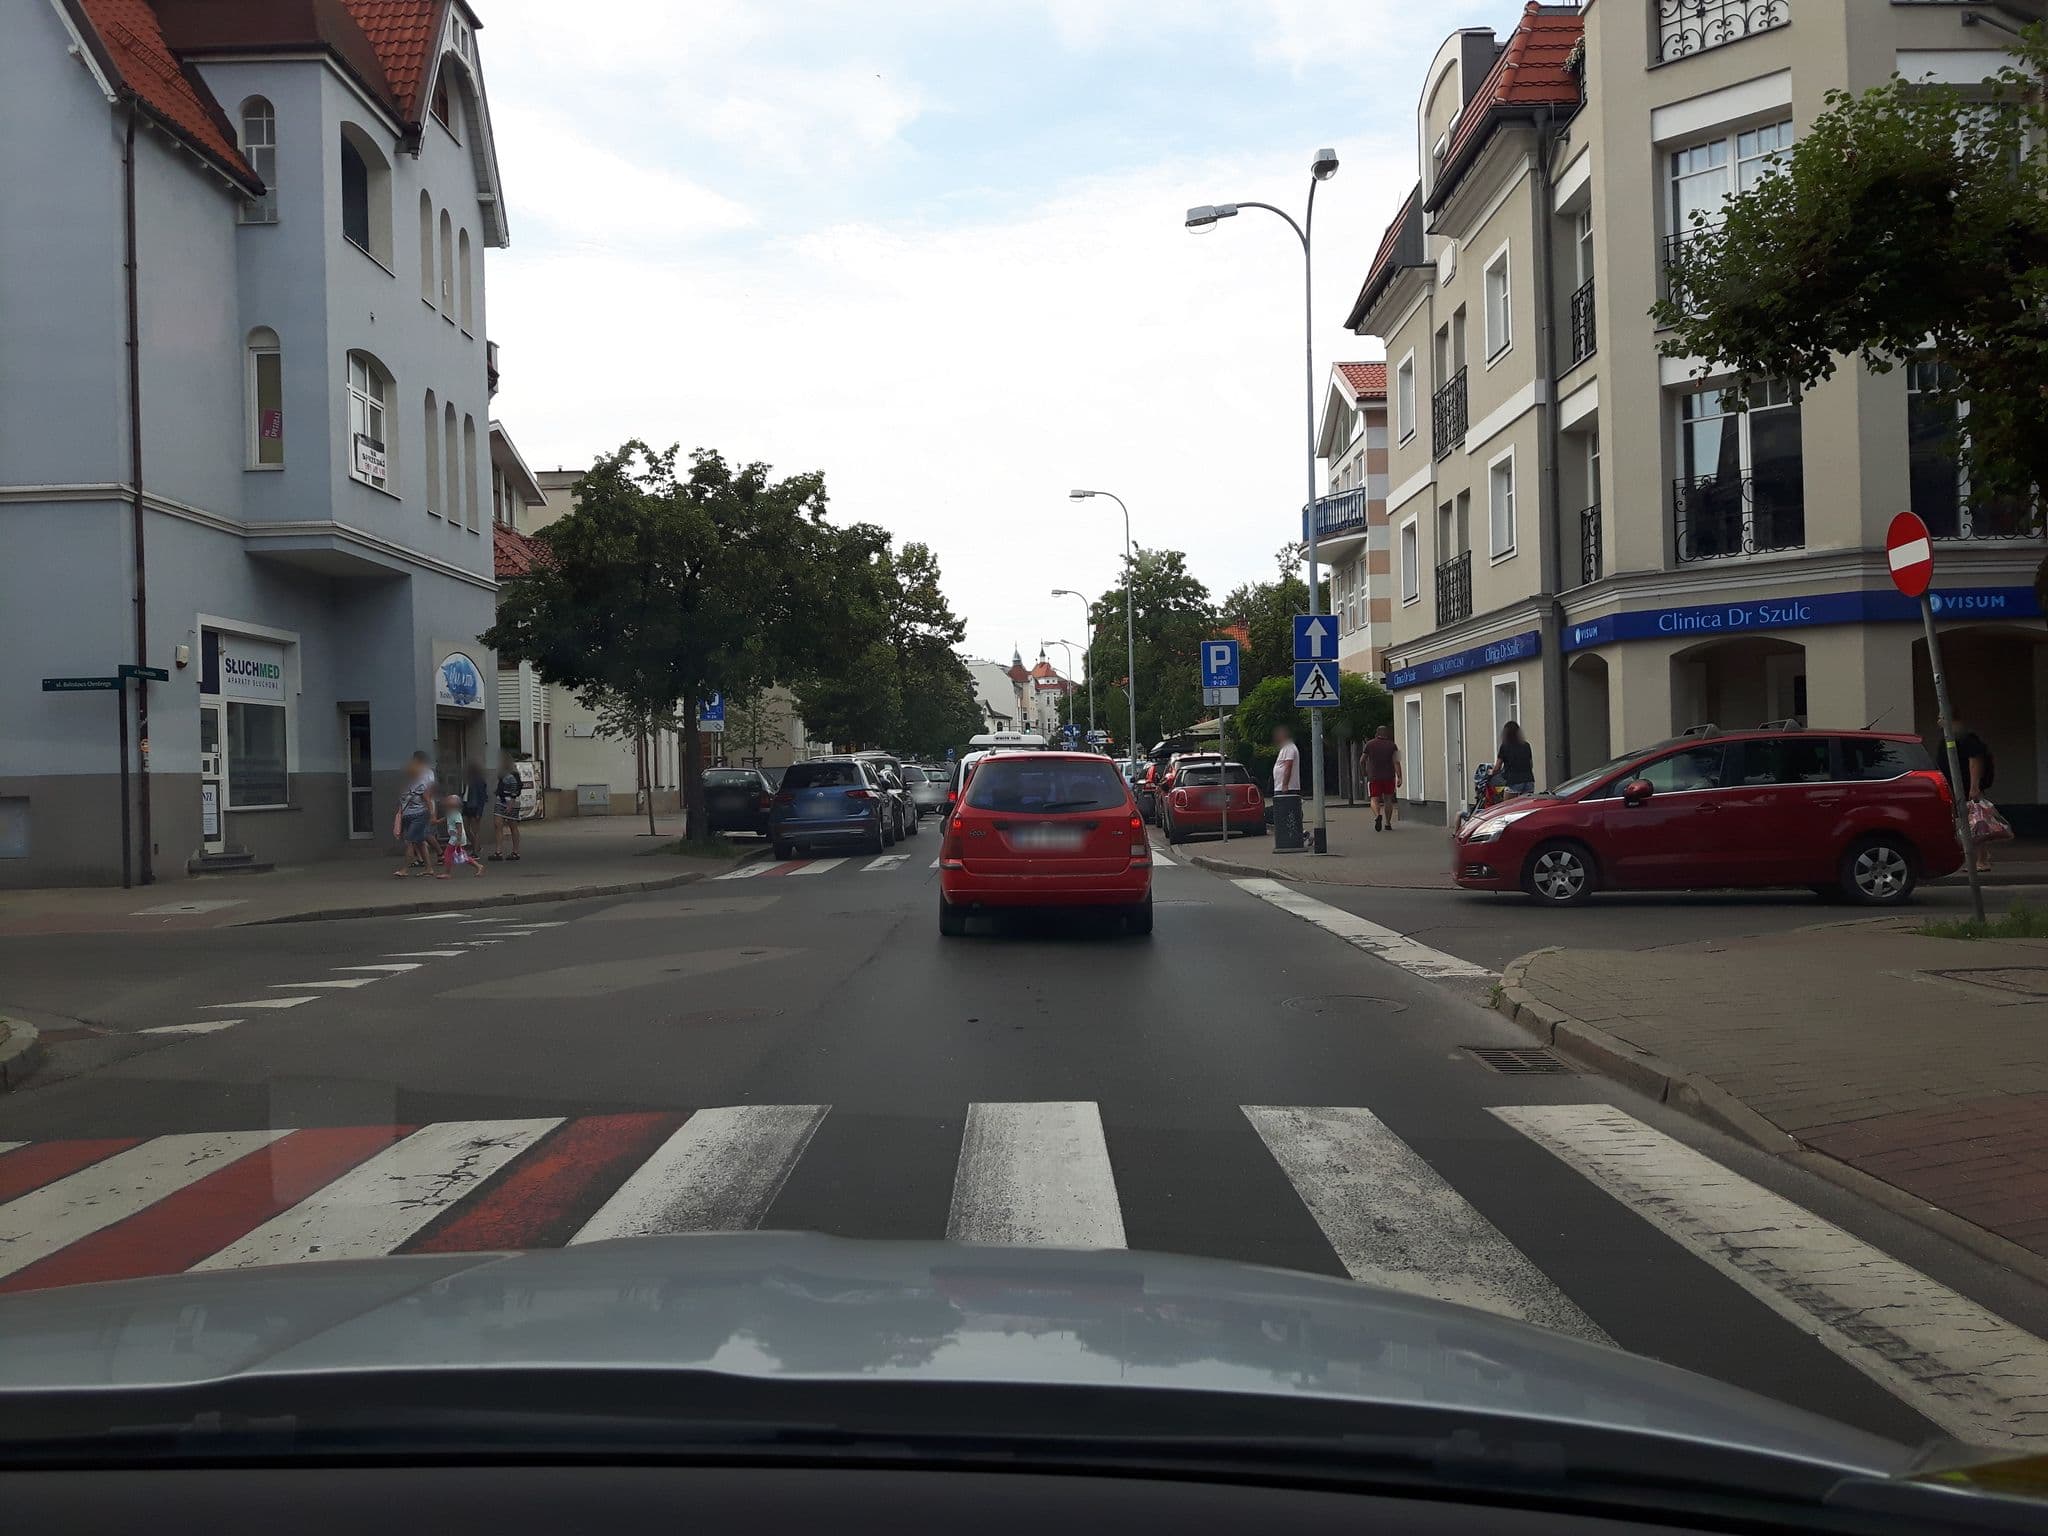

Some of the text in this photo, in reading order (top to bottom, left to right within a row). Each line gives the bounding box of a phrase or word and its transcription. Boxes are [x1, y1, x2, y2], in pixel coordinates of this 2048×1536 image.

[1945, 595, 2005, 608] VISUM
[1659, 602, 1811, 631] Clinica Dr Szulc
[1581, 626, 1598, 640] VISUM
[225, 657, 280, 679] SŁUCHMED
[1210, 645, 1231, 673] P
[228, 677, 250, 686] APARATY
